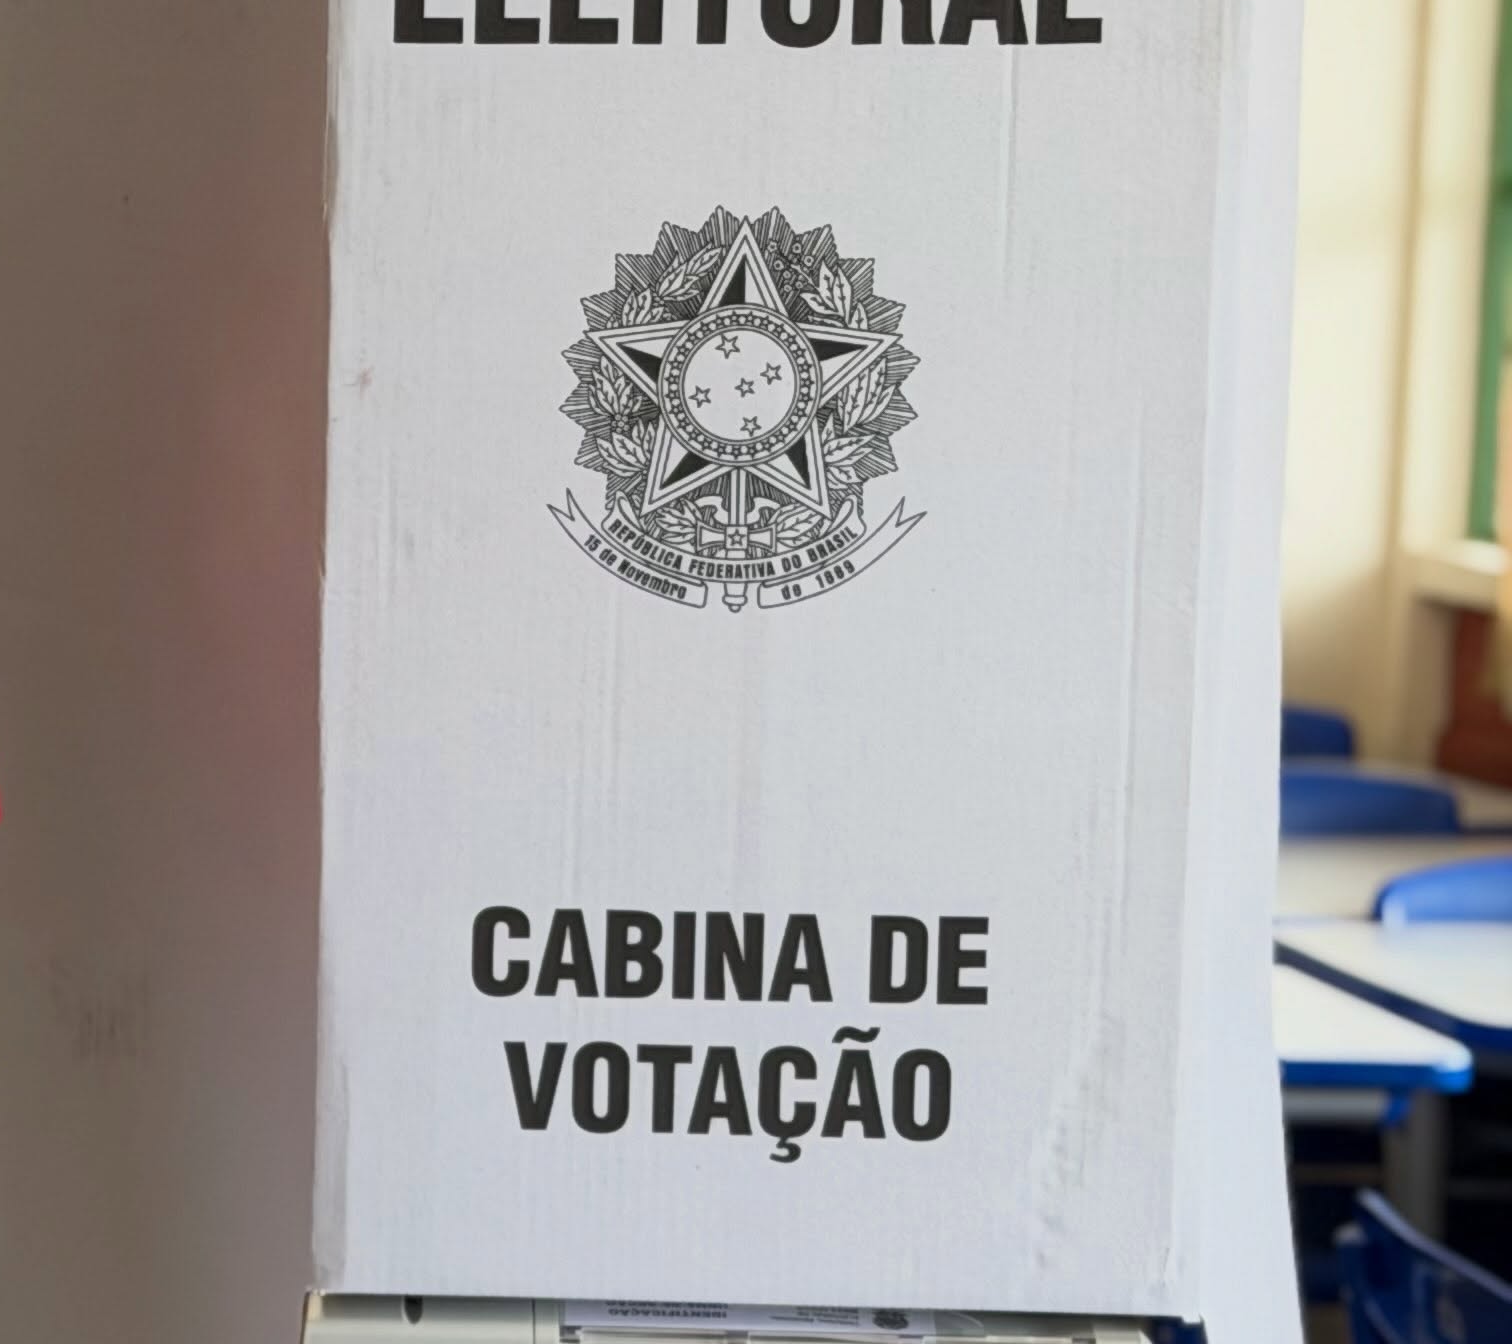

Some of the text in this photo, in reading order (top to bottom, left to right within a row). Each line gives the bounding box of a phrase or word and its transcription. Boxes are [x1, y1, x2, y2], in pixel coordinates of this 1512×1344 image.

[583, 533, 688, 600] 15 de Novembro
[607, 518, 859, 579] REPÚBLICA FEDERATIVA DO BRASIL
[781, 559, 856, 601] de 1889
[470, 905, 989, 1005] CABINA DE
[503, 1025, 952, 1164] VOTAÇÃO
